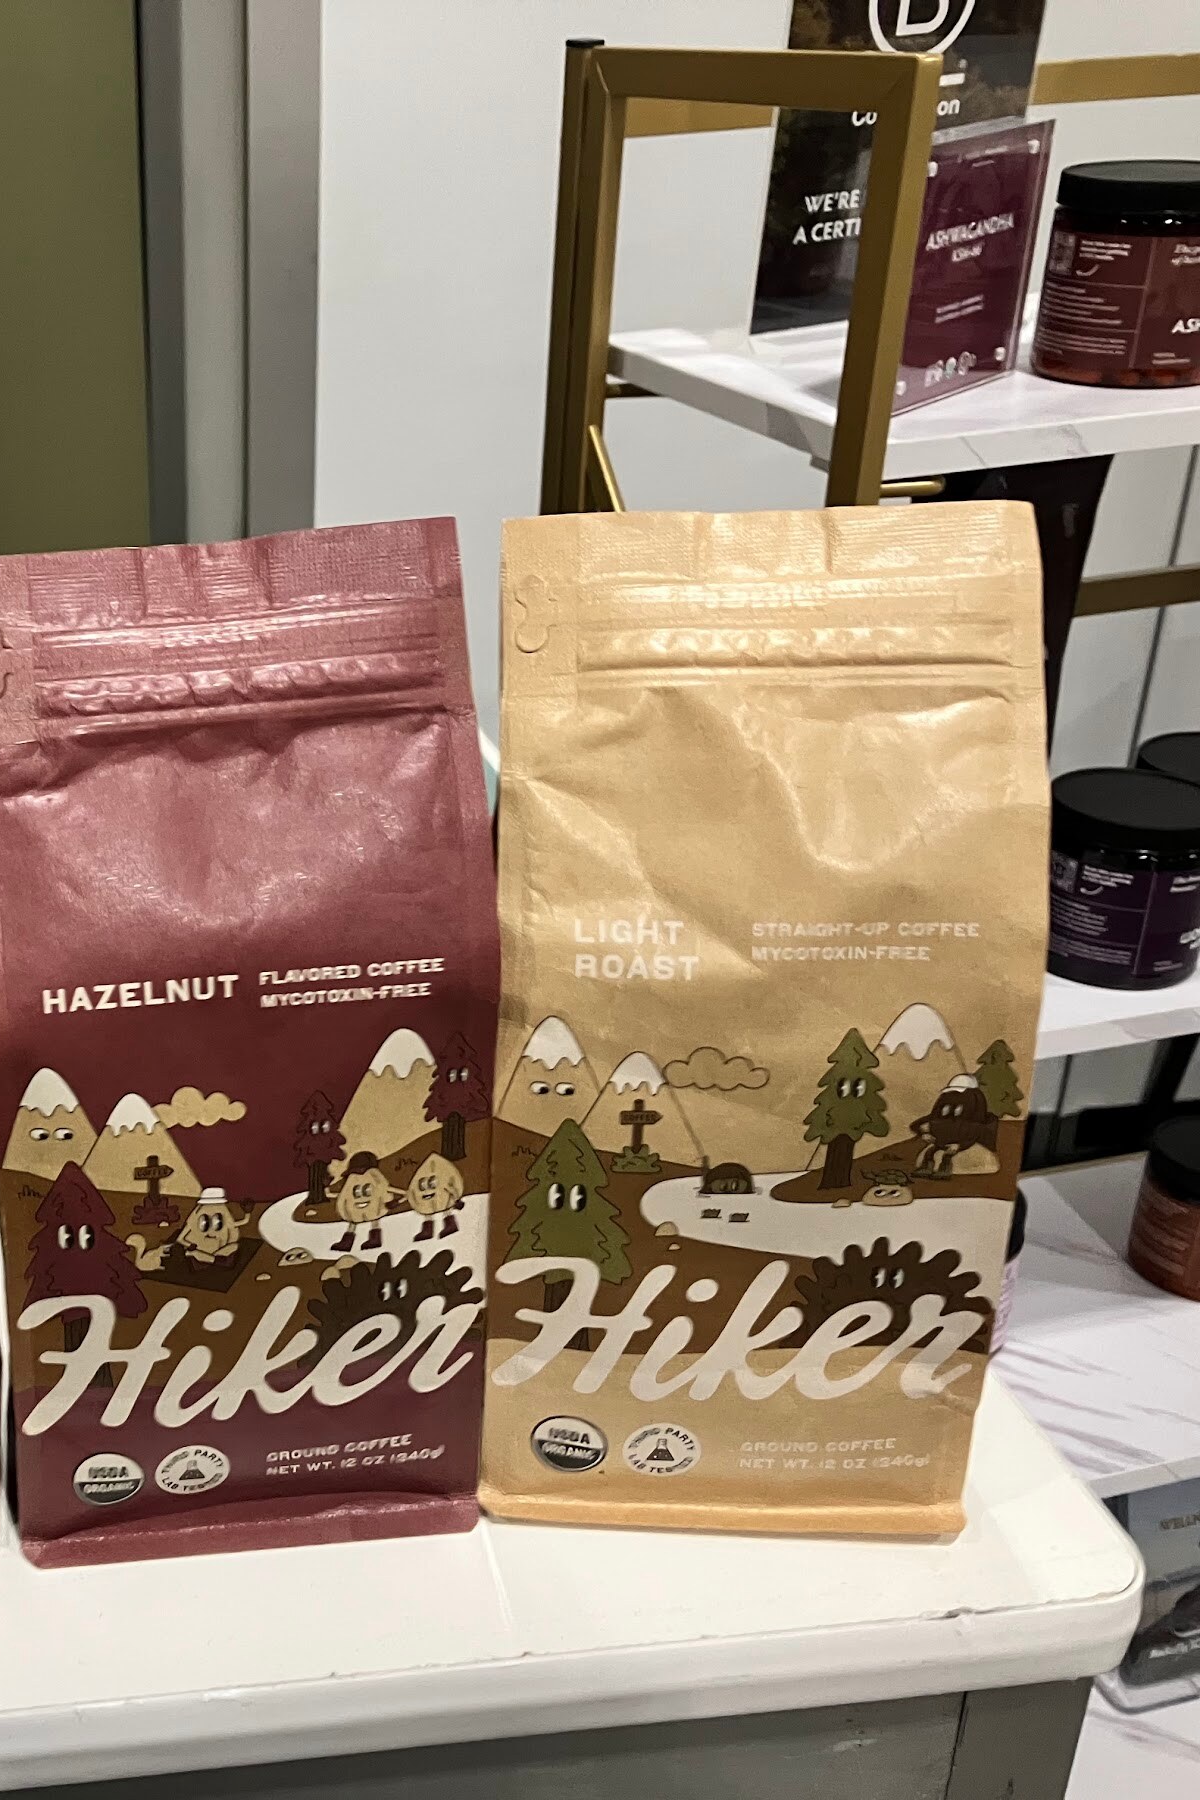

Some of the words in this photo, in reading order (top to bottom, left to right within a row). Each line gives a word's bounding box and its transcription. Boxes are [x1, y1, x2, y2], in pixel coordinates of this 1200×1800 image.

[804, 189, 860, 213] WE'RE
[792, 226, 807, 245] A
[574, 919, 684, 945] LIGHT
[752, 922, 890, 938] STRAIGHT-UP
[898, 922, 980, 937] COFFEE
[751, 945, 931, 961] MYCOTOXIN-FREE
[259, 965, 361, 985] FLAVORED
[367, 958, 445, 977] COFFEE
[574, 953, 699, 980] ROAST
[42, 975, 239, 1014] HAZELNUT
[260, 983, 432, 1008] MYCOTOXIN-FREE
[492, 1256, 986, 1401] Hiker
[17, 1286, 484, 1436] Hiker
[266, 1444, 340, 1462] GROUND
[344, 1433, 412, 1452] COFFEE
[740, 1441, 818, 1452] GROUND
[825, 1437, 897, 1452] COFFEE
[194, 1449, 224, 1468] PARTY
[266, 1464, 300, 1475] NET
[340, 1457, 357, 1468] 12
[361, 1454, 385, 1465] OZ
[739, 1458, 775, 1468] NET
[842, 1458, 867, 1469] OZ
[161, 1477, 179, 1490] LAB
